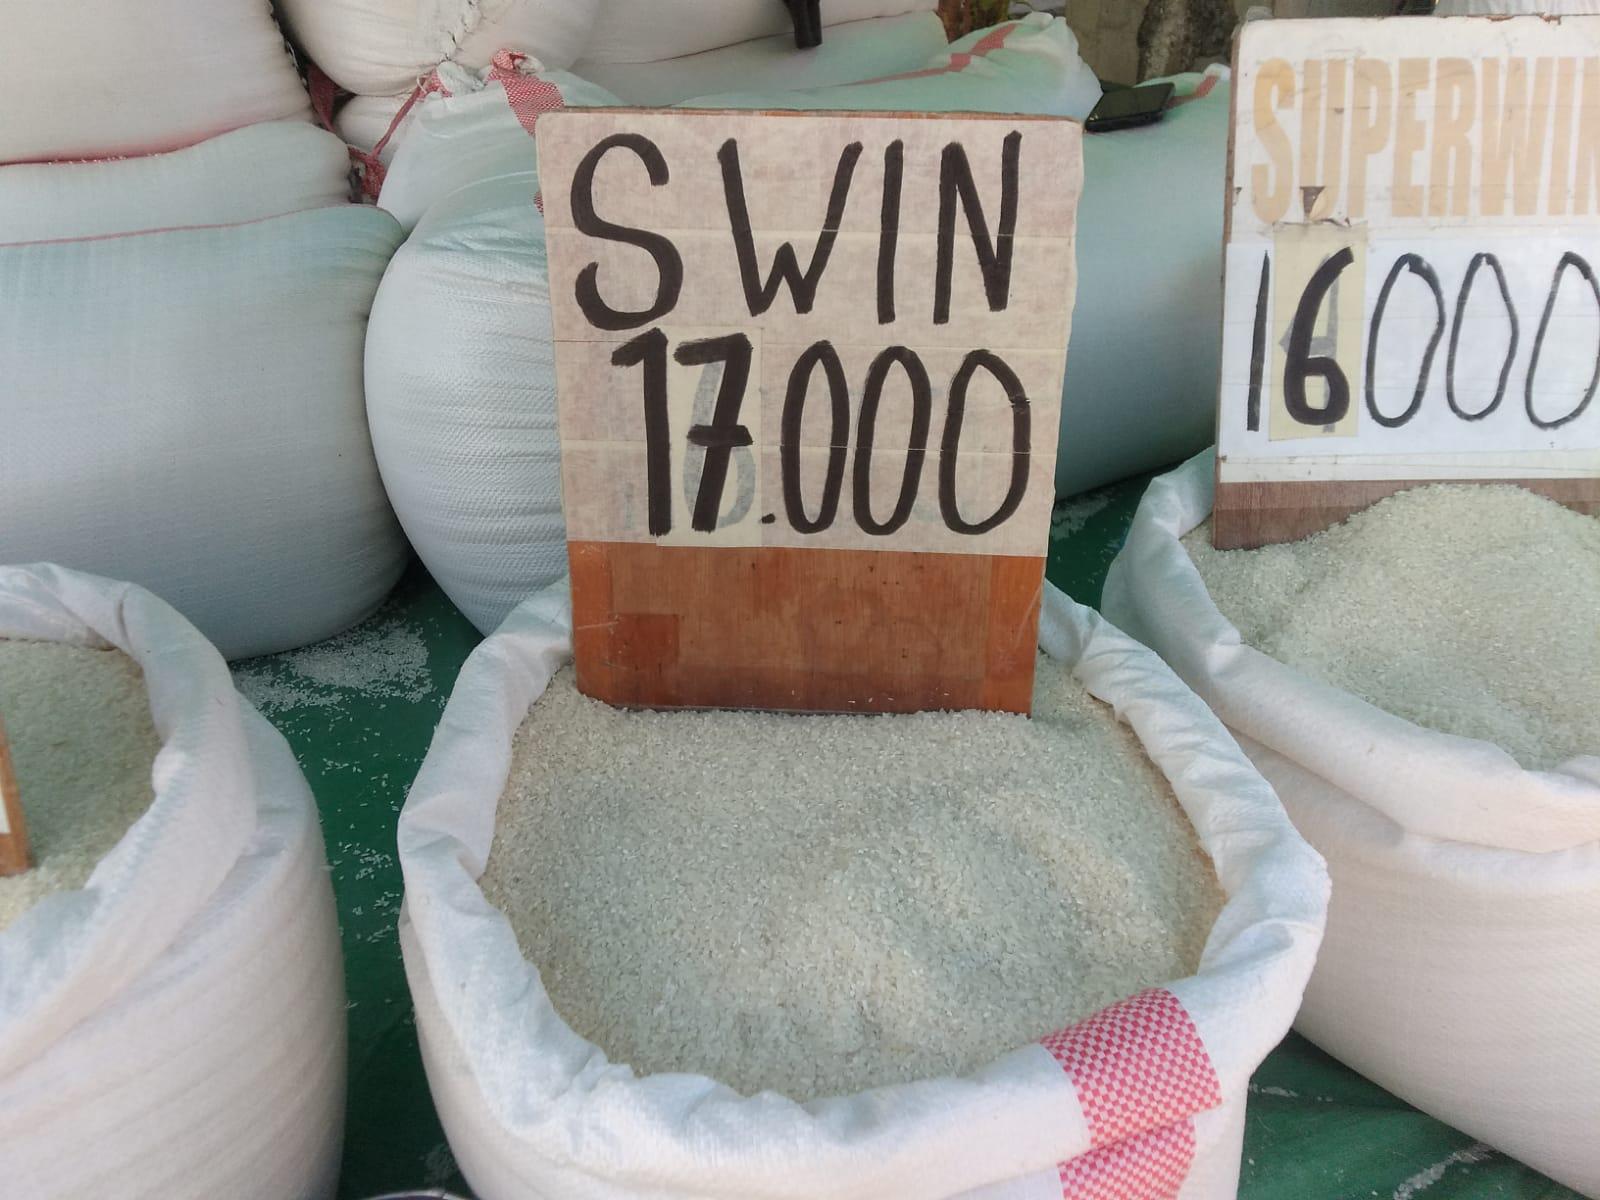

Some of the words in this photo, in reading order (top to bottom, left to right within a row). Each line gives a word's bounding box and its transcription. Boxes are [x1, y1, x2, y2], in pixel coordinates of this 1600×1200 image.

[570, 130, 1022, 331] SWIN
[611, 327, 1032, 536] 17.000
[1246, 246, 1600, 431] 16000
